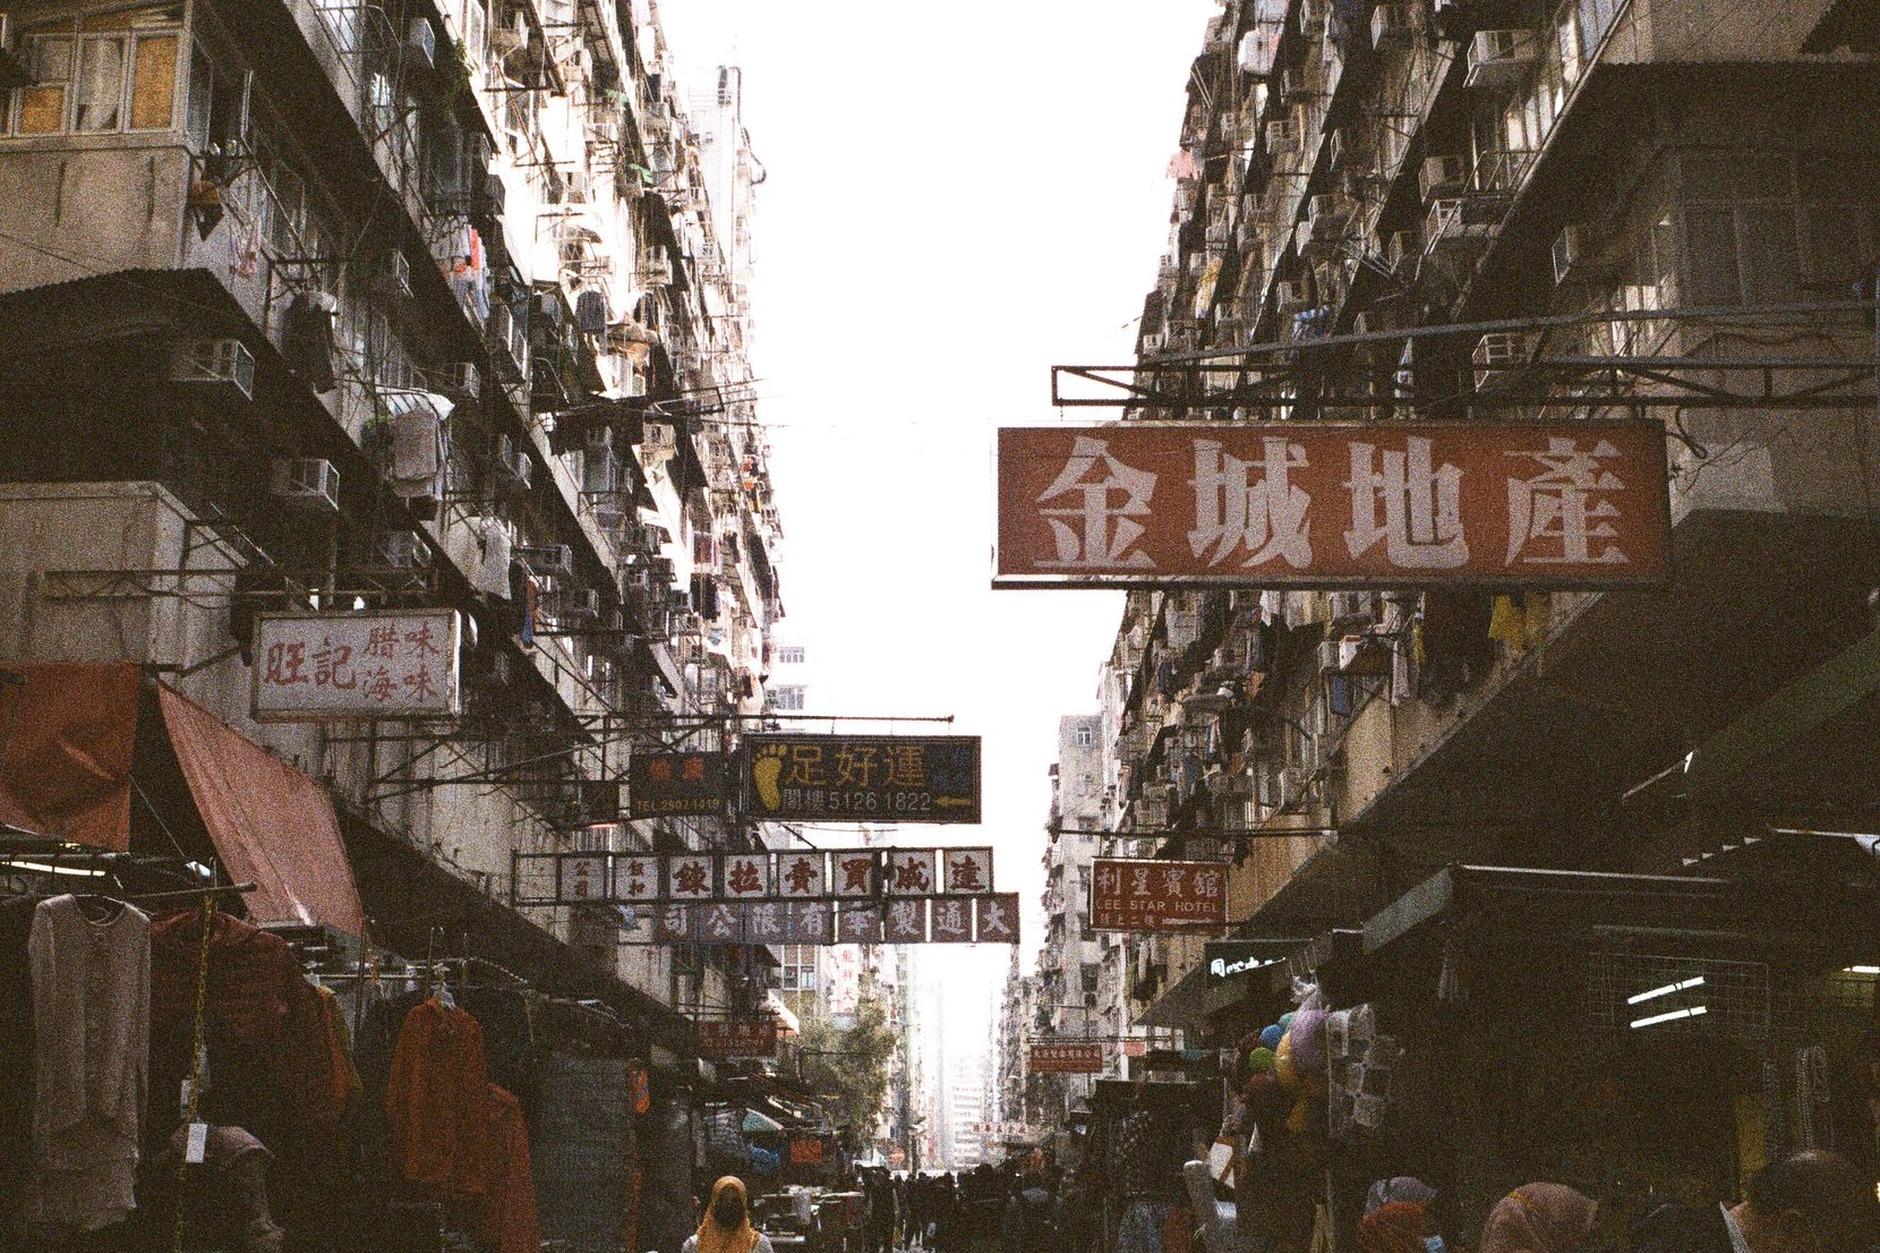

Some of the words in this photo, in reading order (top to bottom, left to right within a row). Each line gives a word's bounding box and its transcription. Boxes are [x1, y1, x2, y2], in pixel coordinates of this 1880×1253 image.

[1034, 436, 1630, 571] 金城地產
[264, 636, 357, 690] 旺記
[363, 664, 439, 702] 海味
[784, 743, 926, 788] 足好運
[828, 791, 878, 812] 5126
[885, 791, 932, 812] 1822
[1130, 900, 1167, 910] STAR
[1175, 901, 1219, 913] HOTEL
